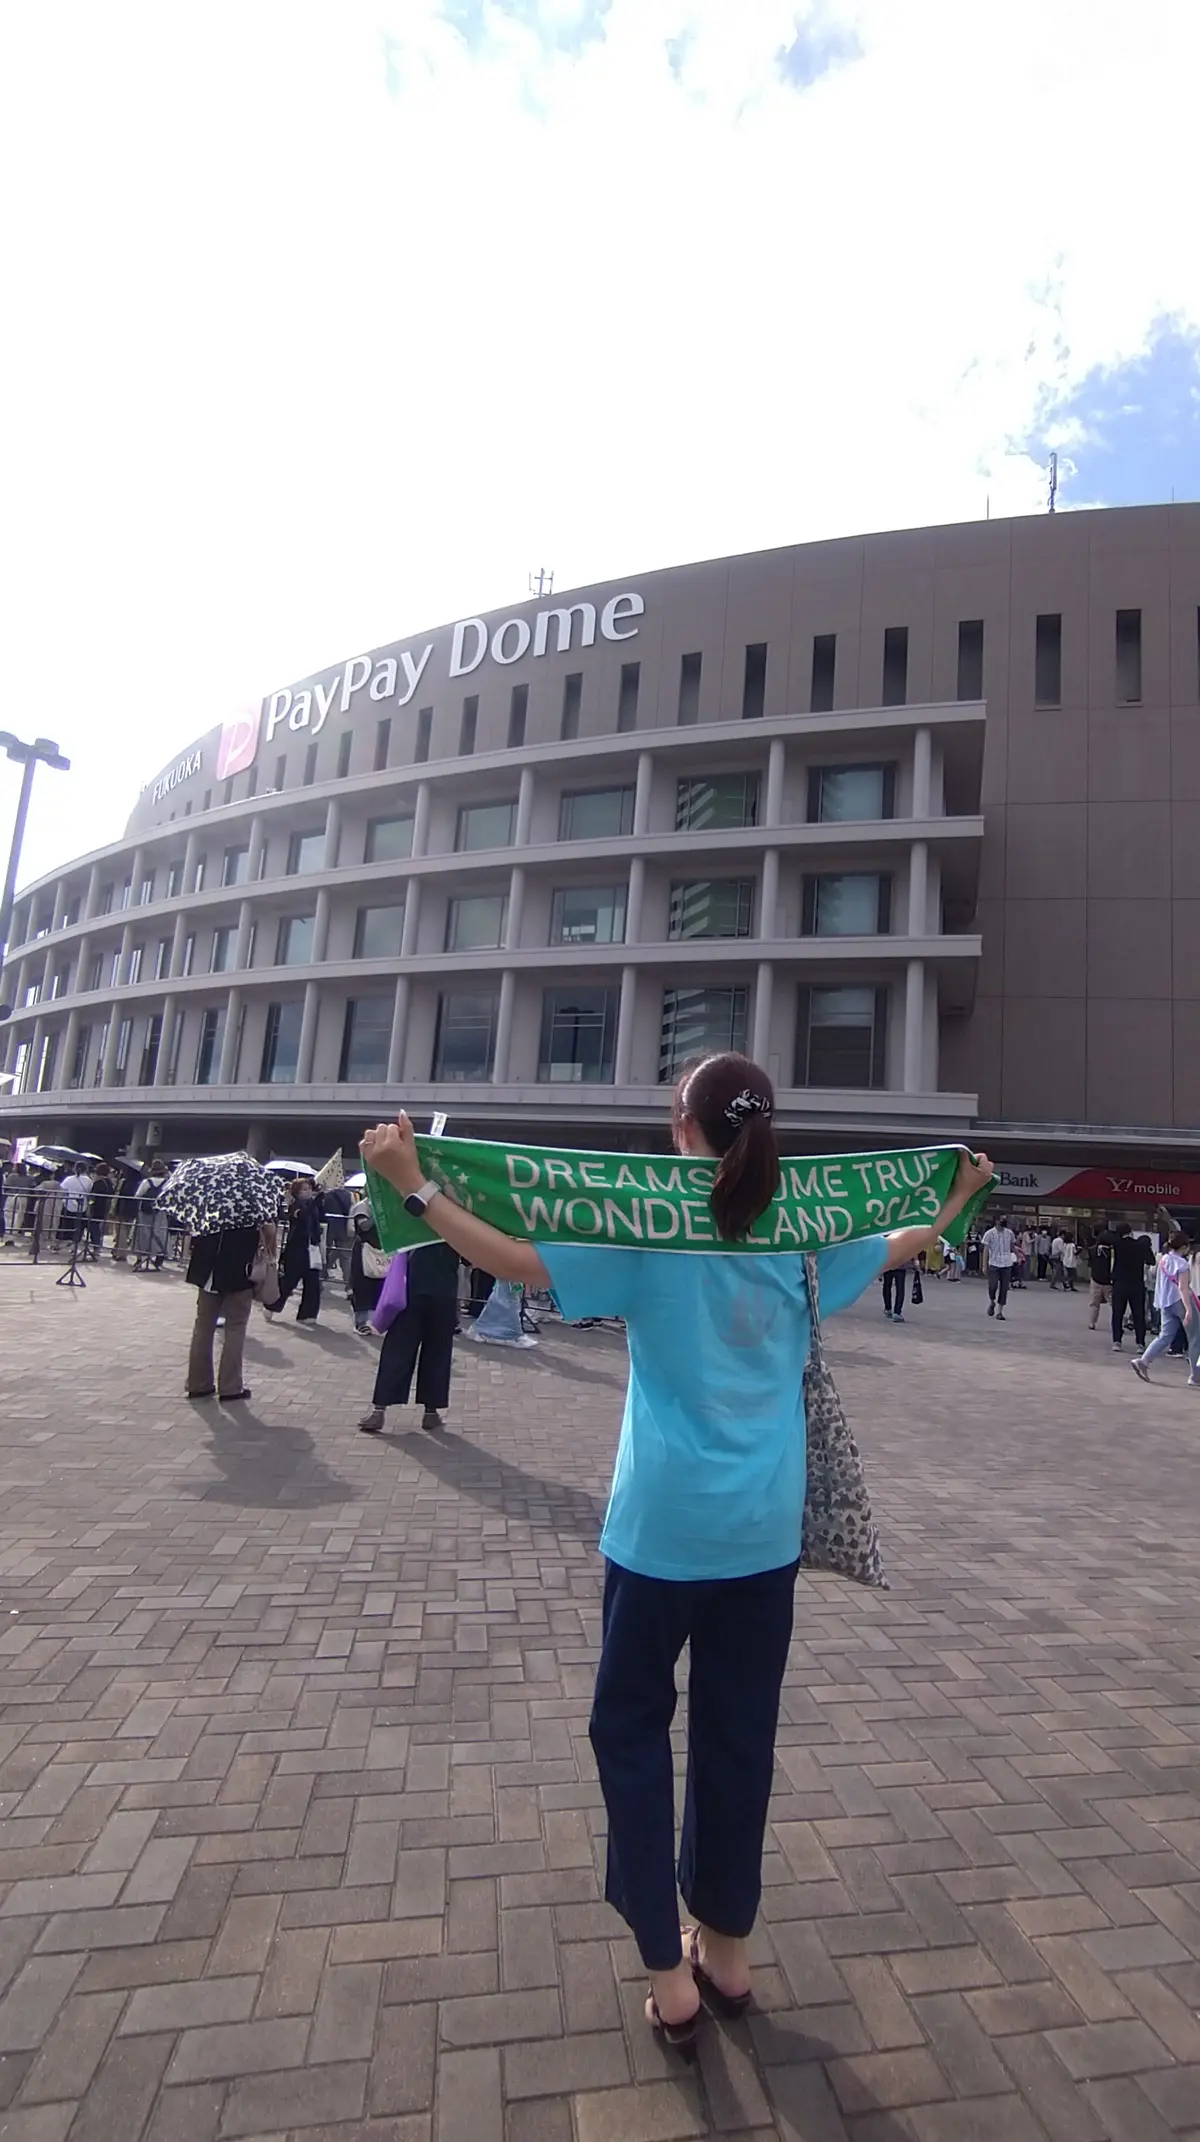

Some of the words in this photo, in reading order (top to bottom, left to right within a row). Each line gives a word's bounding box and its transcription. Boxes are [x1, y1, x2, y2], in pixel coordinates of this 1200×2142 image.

[152, 750, 202, 805] FUKUOKA
[266, 645, 433, 741] PayPay
[449, 593, 645, 678] Dome
[505, 1154, 716, 1195] DREAMS
